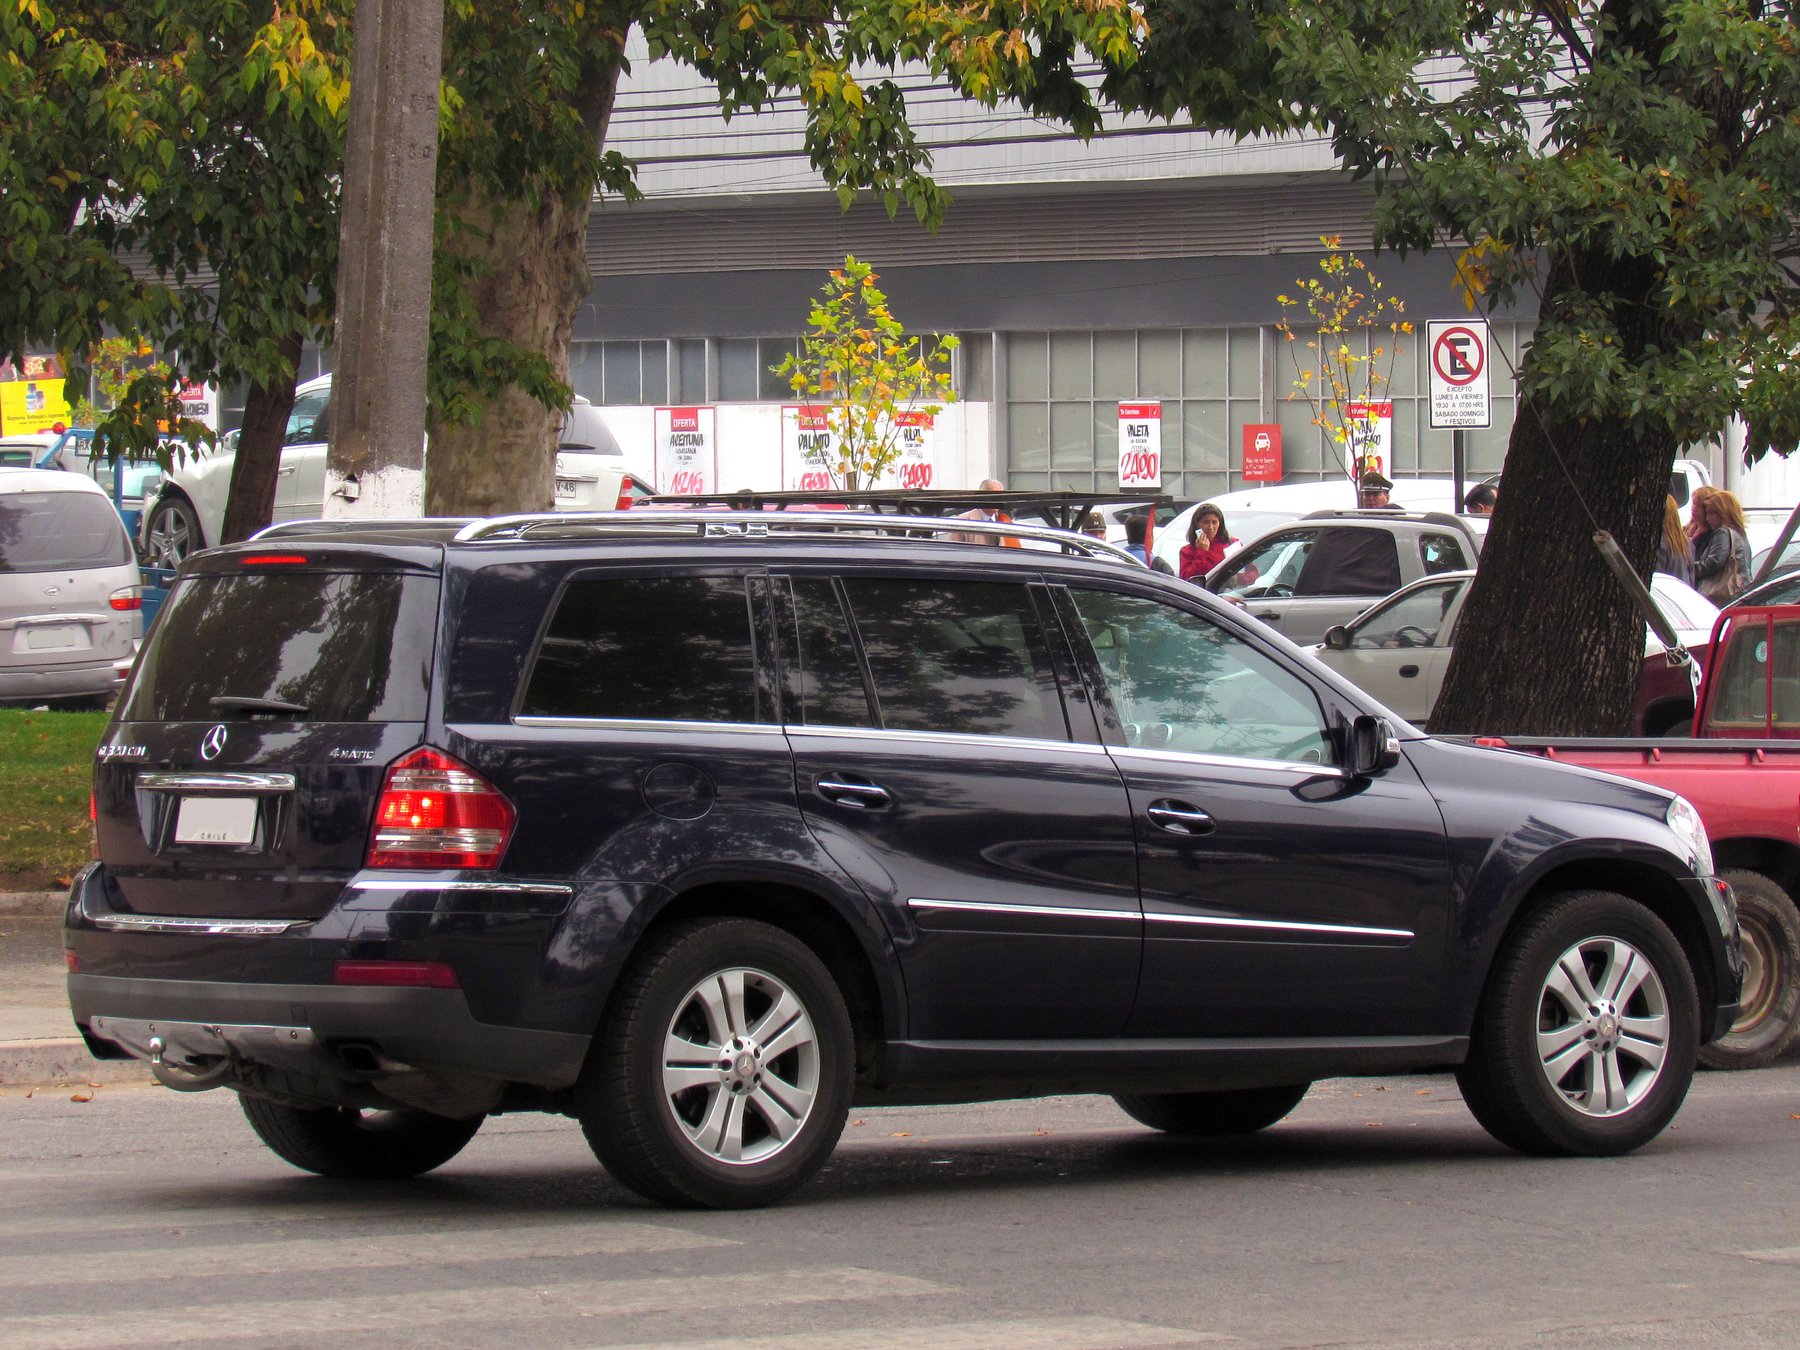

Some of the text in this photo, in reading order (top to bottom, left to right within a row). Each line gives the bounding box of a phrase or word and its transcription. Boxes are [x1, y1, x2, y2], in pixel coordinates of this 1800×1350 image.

[673, 419, 696, 428] OFERTA
[669, 433, 704, 448] ACEITUNA
[201, 833, 227, 841] CHILE
